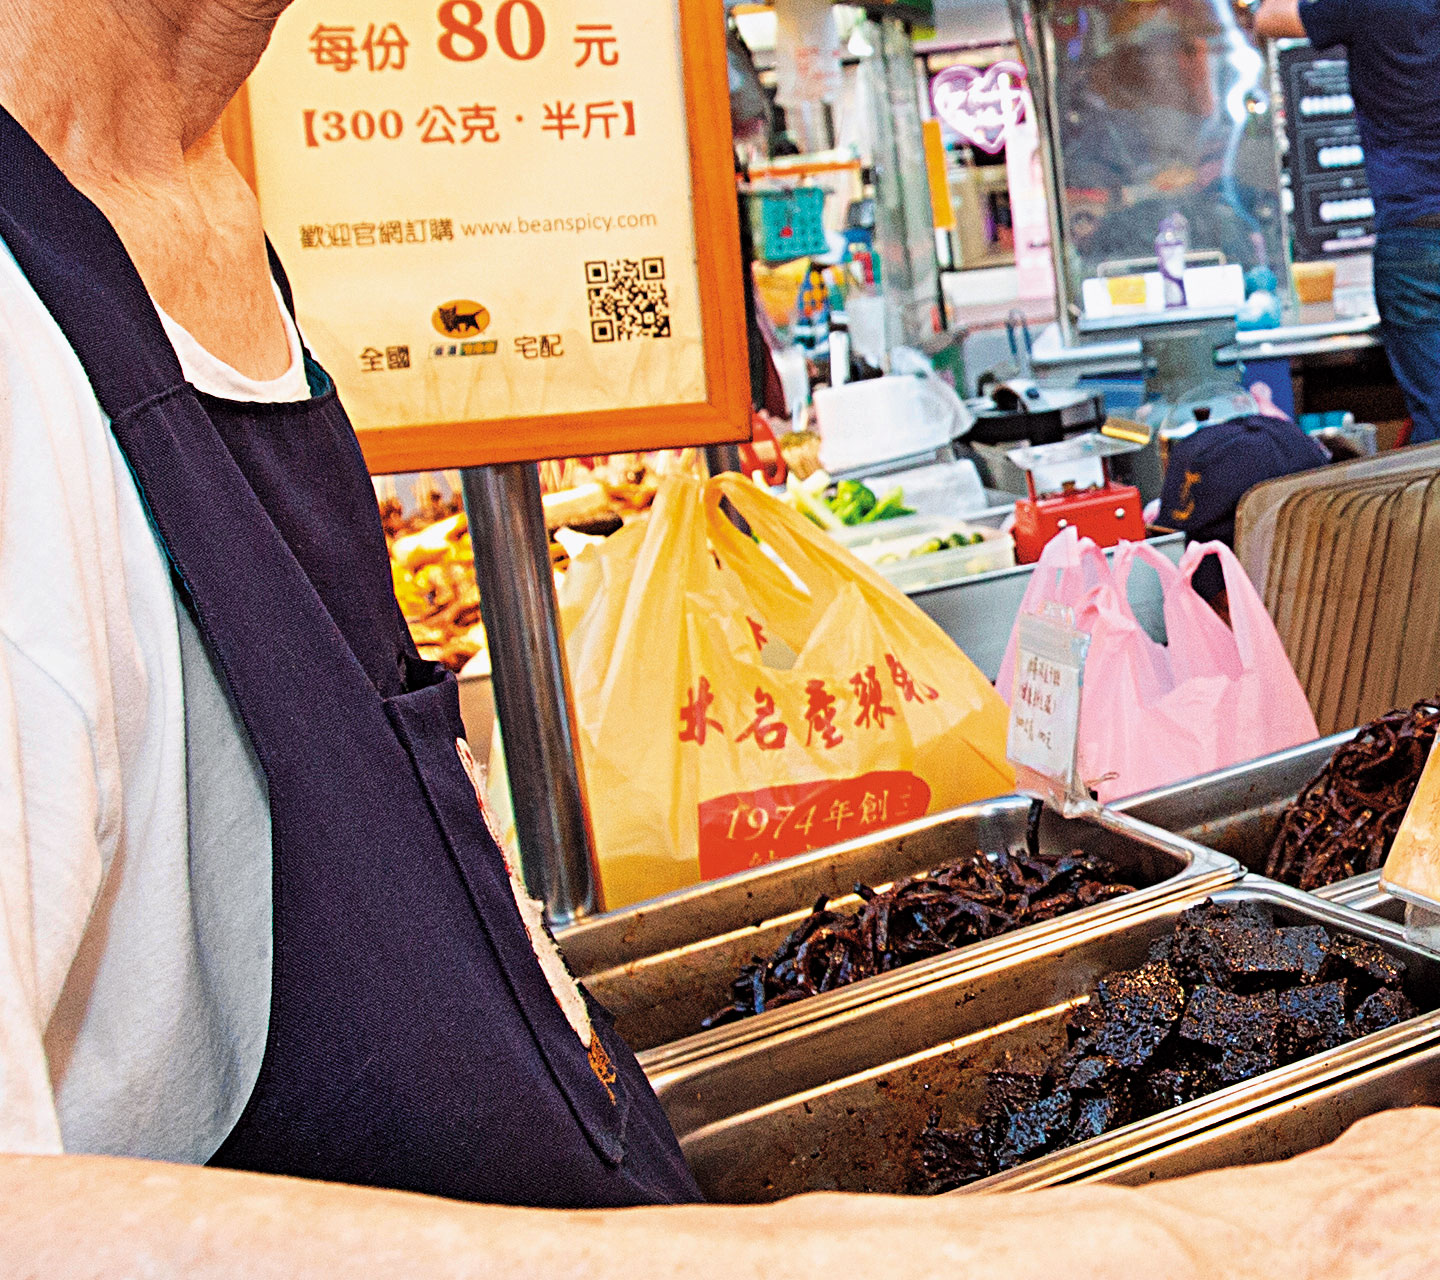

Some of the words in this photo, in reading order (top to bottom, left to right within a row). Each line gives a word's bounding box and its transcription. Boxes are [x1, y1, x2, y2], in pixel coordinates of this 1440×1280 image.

[308, 23, 410, 72] 每份
[573, 24, 620, 68] 元
[299, 218, 454, 250] 歡迎官網訂購
[460, 211, 658, 237] www.beanspicy.com
[360, 345, 411, 372] 全國
[514, 334, 564, 360] 宅配
